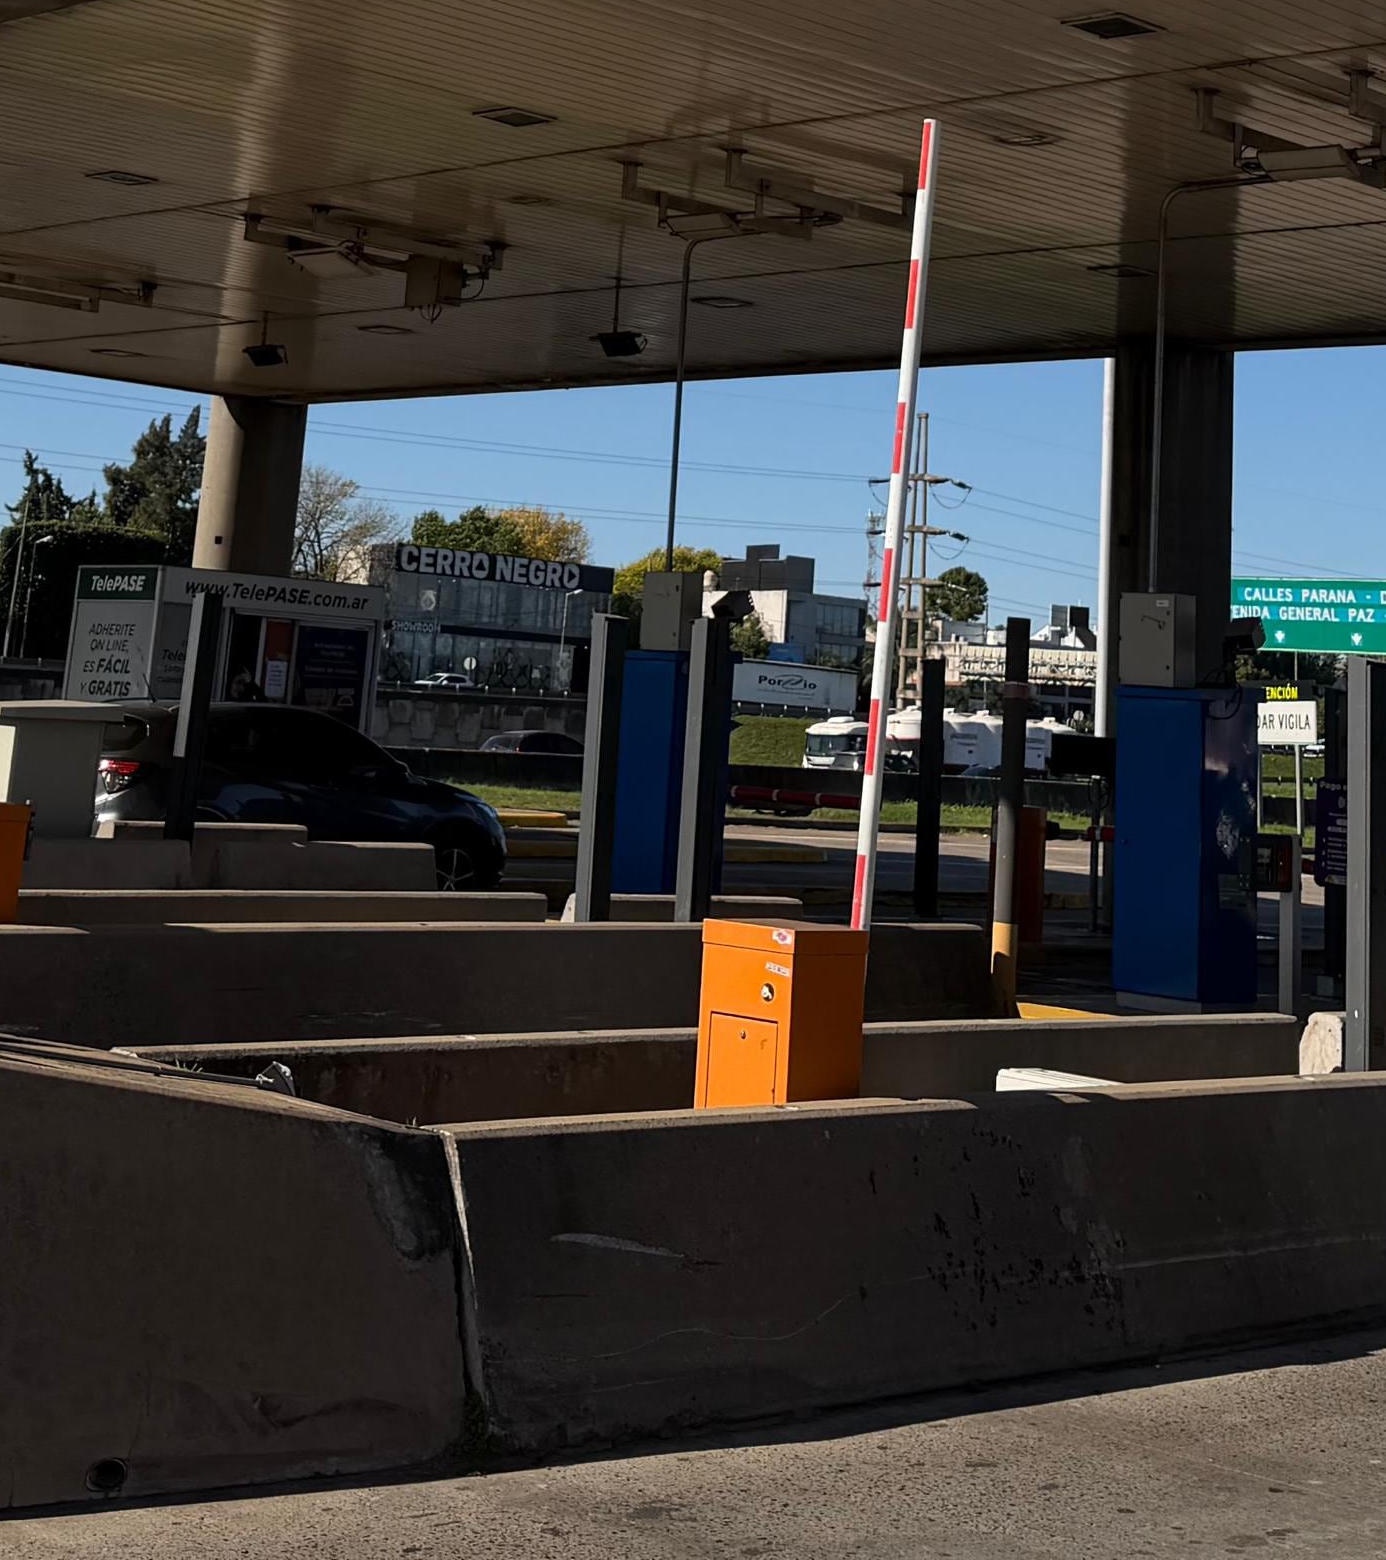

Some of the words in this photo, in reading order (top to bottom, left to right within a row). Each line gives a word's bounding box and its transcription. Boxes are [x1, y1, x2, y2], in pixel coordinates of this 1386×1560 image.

[400, 545, 490, 579] CERRO
[494, 555, 581, 589] NEGRO
[91, 574, 146, 592] TelePASE
[1244, 588, 1293, 602] CALLES
[1301, 589, 1356, 603] PARANA
[1231, 605, 1270, 619] ENIDA
[1279, 606, 1339, 622] GENERAL
[1348, 607, 1375, 622] PAZ
[88, 623, 137, 636] ADHERITE
[90, 638, 105, 651] ON
[163, 648, 186, 661] Tele
[83, 660, 95, 673] ES
[96, 654, 131, 674] FÁCIL
[88, 680, 131, 697] GRATIS
[1265, 683, 1298, 700] ENCIÓN
[1278, 713, 1311, 730] VIGILA
